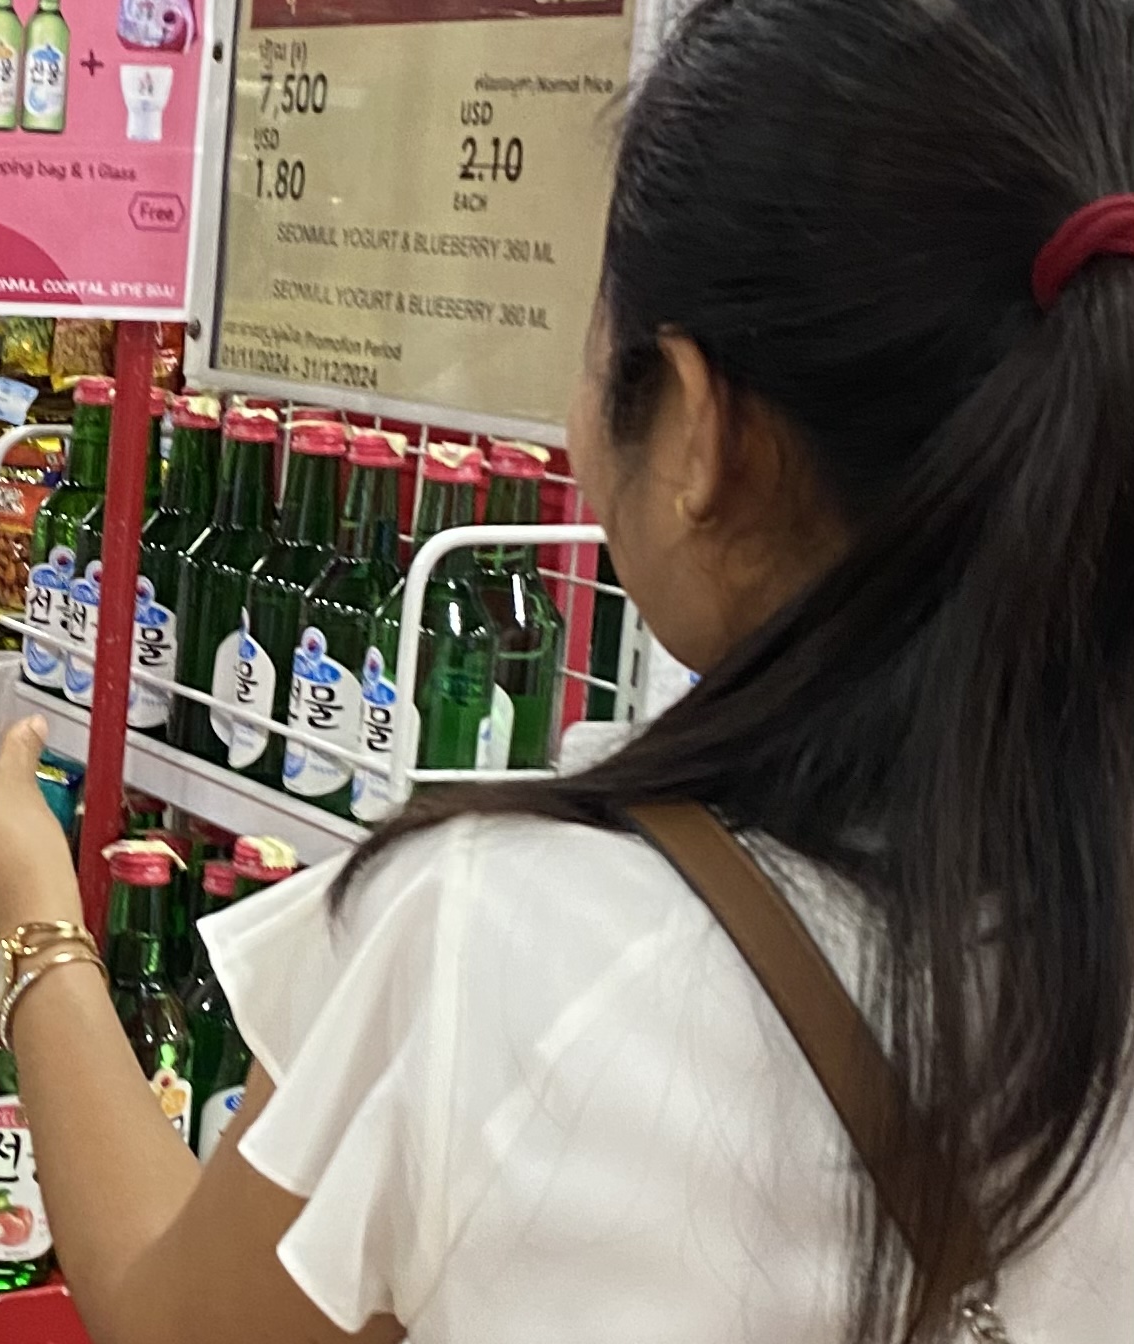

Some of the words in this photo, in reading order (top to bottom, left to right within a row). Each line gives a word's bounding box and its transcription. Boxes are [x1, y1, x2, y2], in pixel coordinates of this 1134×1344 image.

[259, 72, 329, 119] 7,500
[460, 99, 494, 127] USD
[253, 127, 280, 151] USD
[37, 160, 66, 182] bag
[70, 163, 83, 179] &
[97, 163, 137, 182] Glass
[459, 135, 524, 183] 2.10
[253, 158, 306, 201] 1.80
[138, 200, 175, 222] Free
[453, 191, 488, 212] EACH
[277, 221, 338, 248] SEONMUL
[342, 227, 399, 253] YOGURT
[401, 232, 412, 253] &
[413, 232, 501, 262] BLUEBERRY
[533, 241, 557, 265] ML
[272, 278, 333, 306] SEONMUL
[336, 287, 393, 312] YOGURT
[395, 292, 406, 314] &
[408, 293, 496, 322] BLUEBERRY
[528, 307, 552, 331] ML
